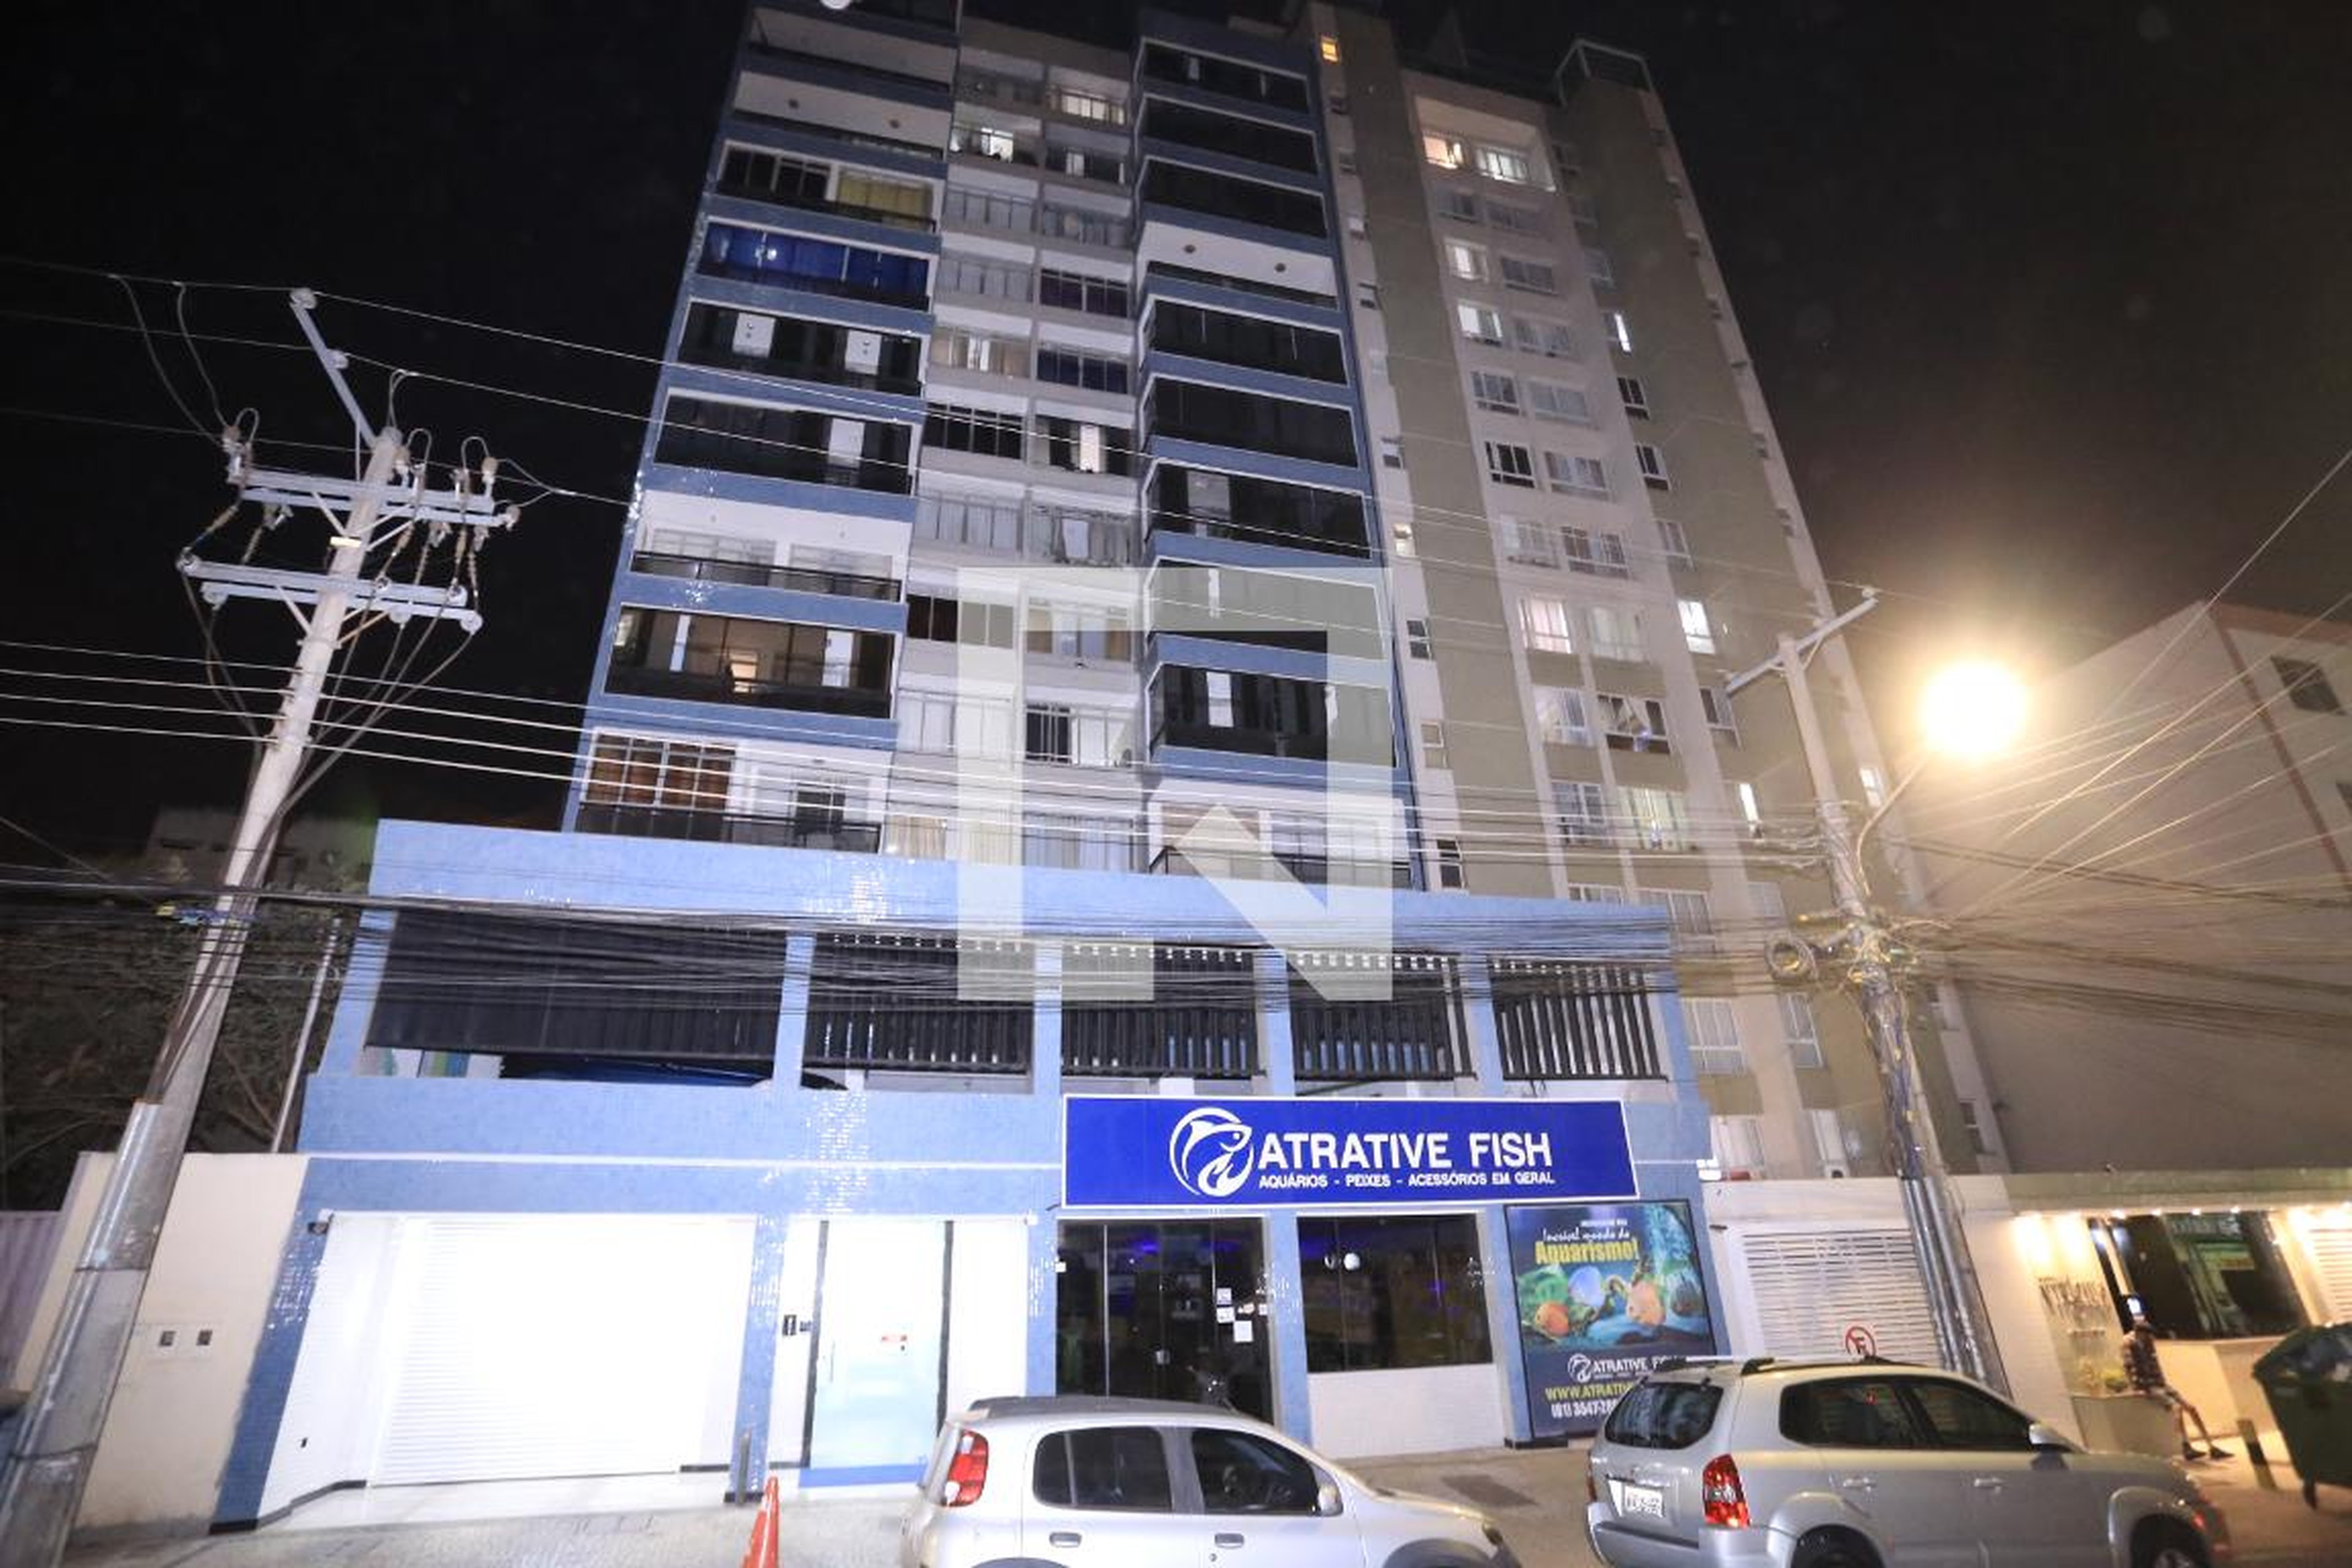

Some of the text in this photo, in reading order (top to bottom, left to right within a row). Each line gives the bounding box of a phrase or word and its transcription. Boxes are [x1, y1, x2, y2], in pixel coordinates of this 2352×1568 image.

[1258, 1133, 1552, 1169] ATRATIVE FISH
[1259, 1172, 1328, 1188] AQUÁRIOS
[1346, 1174, 1391, 1187] PEIXES
[1408, 1170, 1487, 1186] ACESSÓRIOS
[1492, 1173, 1511, 1185] EM
[1514, 1172, 1556, 1185] GERAL
[1535, 1237, 1640, 1265] Aquarismo!
[1594, 1356, 1648, 1373] ATRATIVE
